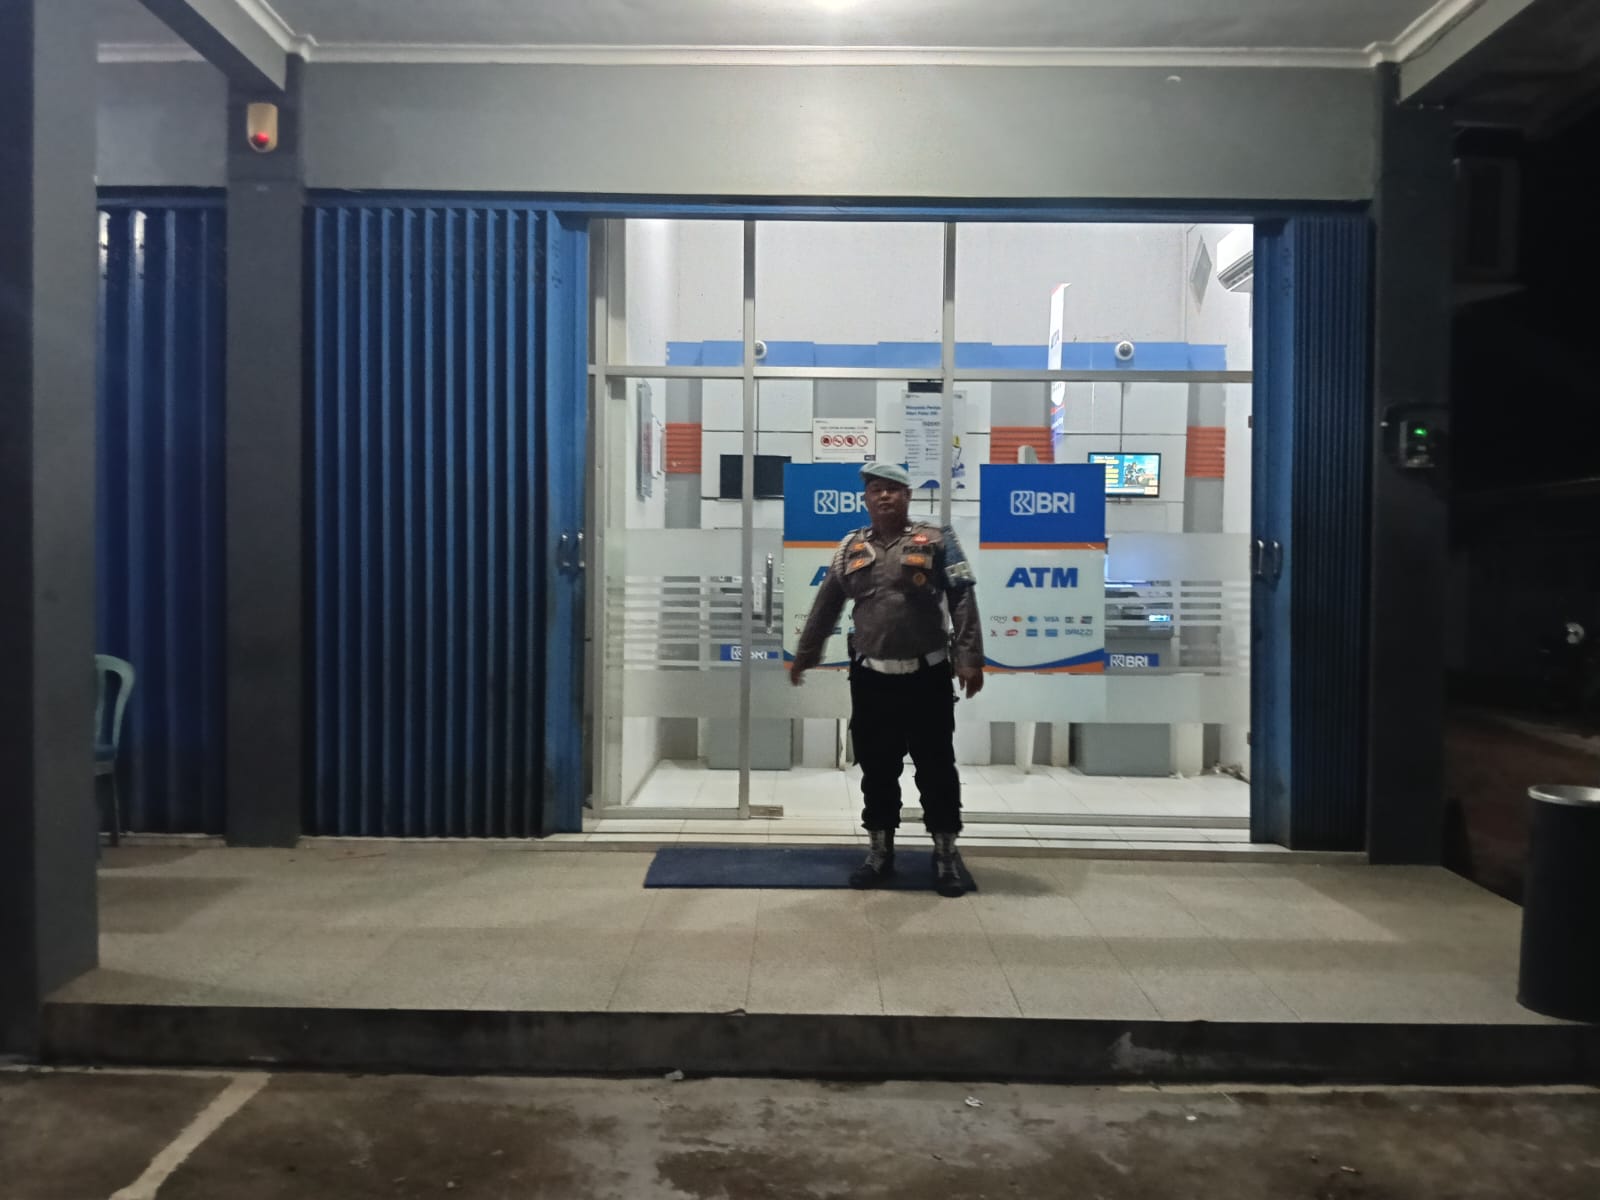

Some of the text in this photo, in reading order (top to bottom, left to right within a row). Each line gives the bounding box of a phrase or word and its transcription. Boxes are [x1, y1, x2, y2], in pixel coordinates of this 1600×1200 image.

[840, 491, 869, 513] BR
[1036, 492, 1075, 514] BRI
[1006, 567, 1079, 588] ATM
[1126, 655, 1149, 668] BRI
